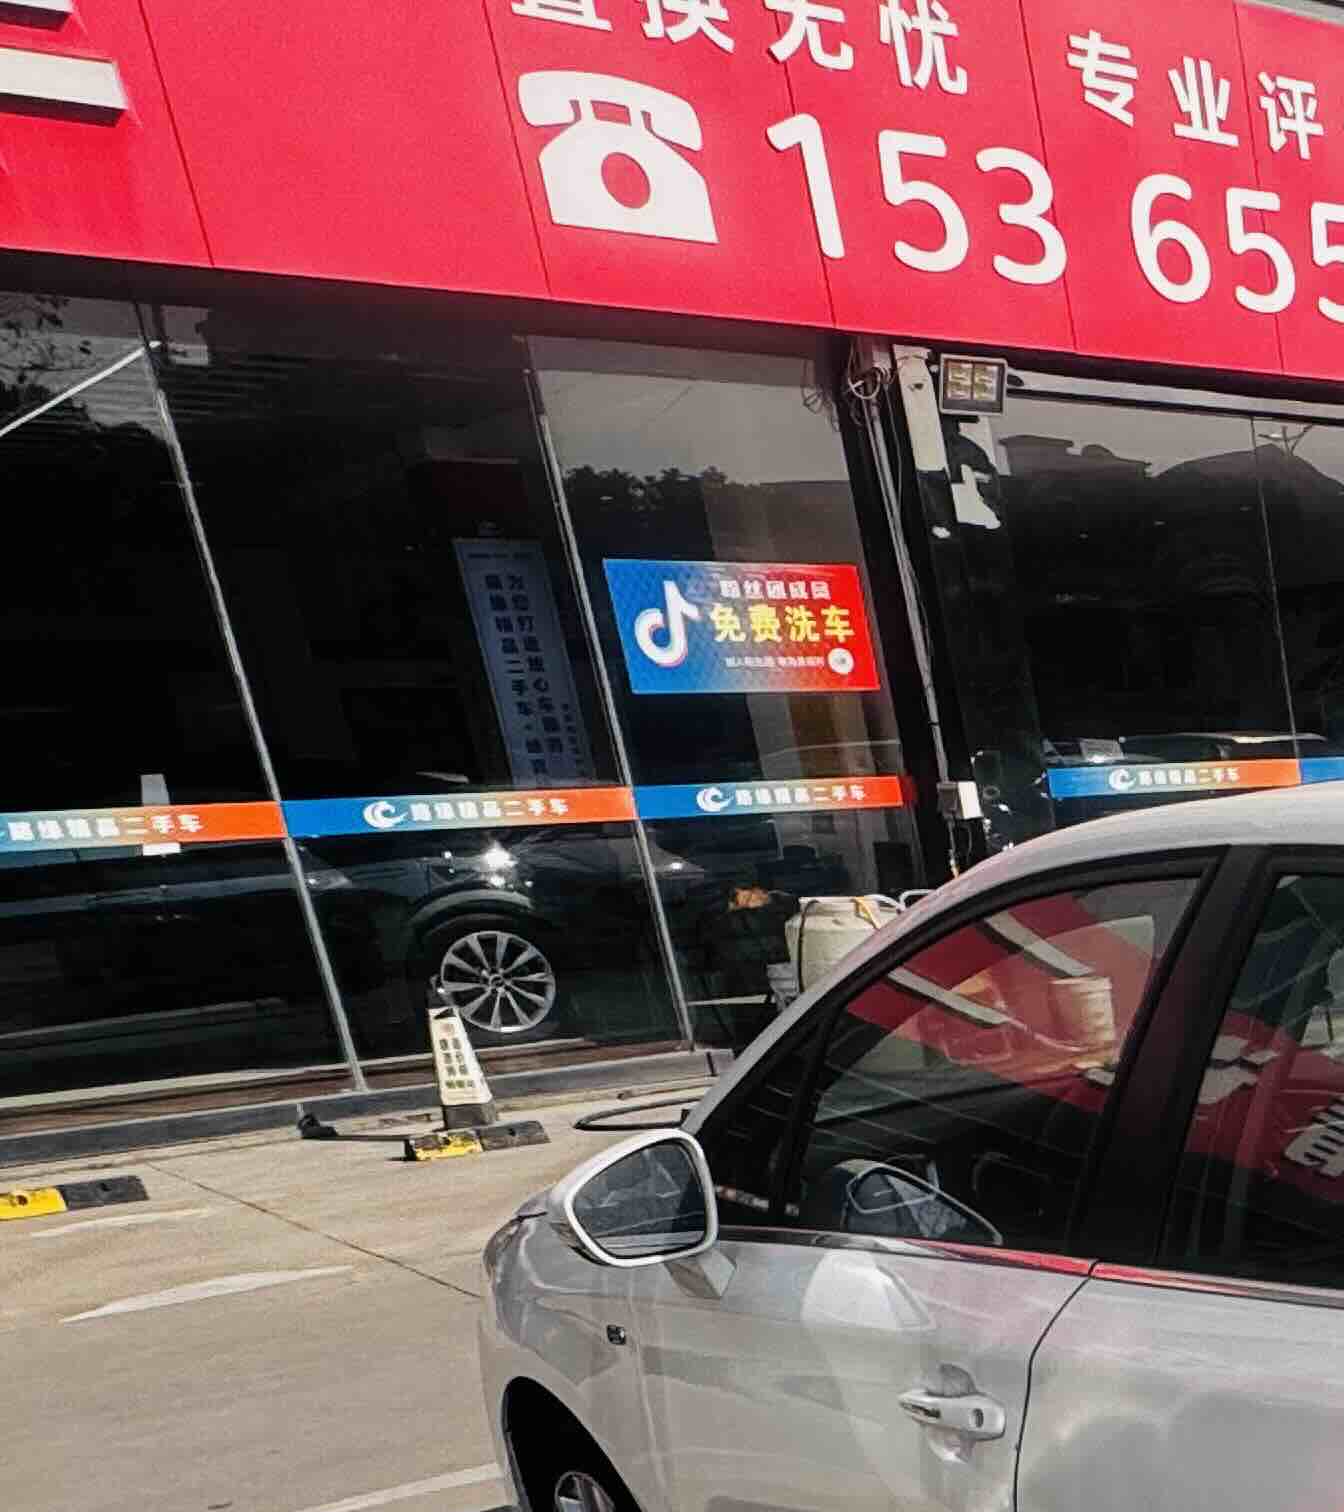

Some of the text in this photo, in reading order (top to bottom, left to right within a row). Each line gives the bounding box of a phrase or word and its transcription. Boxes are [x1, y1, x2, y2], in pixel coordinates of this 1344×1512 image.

[765, 113, 1068, 286] 153
[709, 603, 855, 642] 免费洗车
